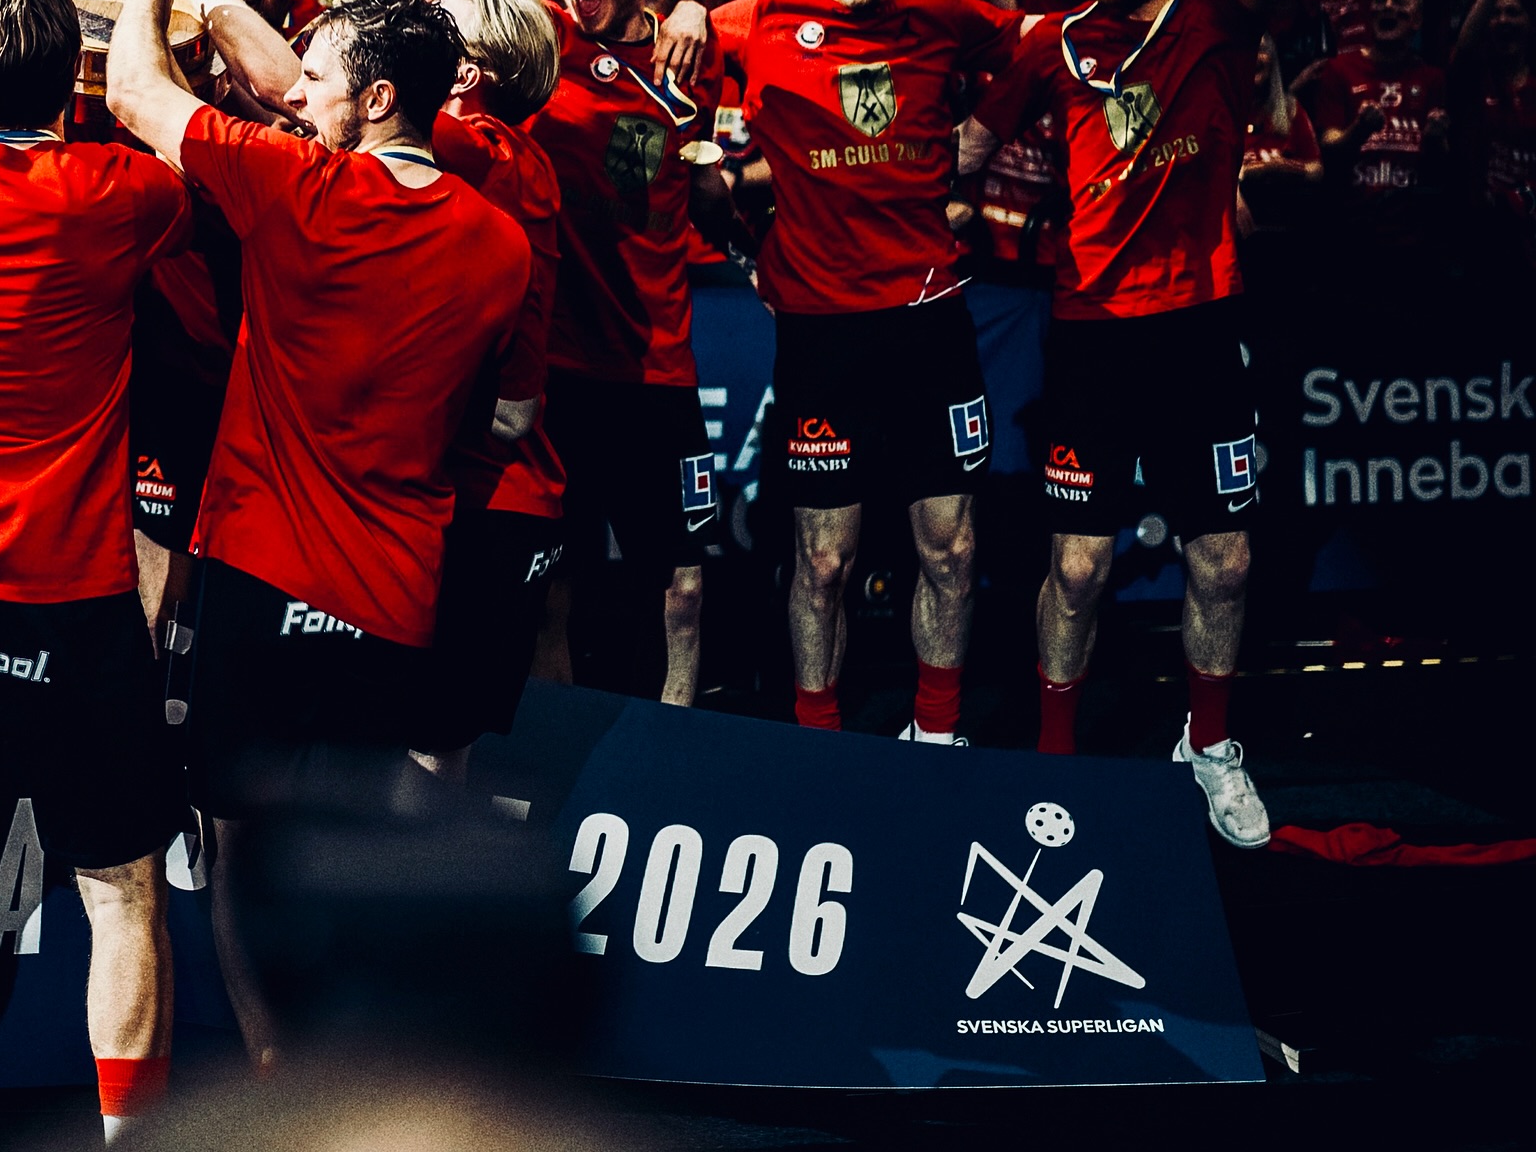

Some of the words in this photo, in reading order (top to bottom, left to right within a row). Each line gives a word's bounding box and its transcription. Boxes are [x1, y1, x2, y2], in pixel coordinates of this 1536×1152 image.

[808, 144, 890, 170] SM-GULD
[1150, 134, 1200, 168] 2026
[1301, 359, 1536, 428] Svensk
[796, 417, 837, 439] ICA
[789, 440, 848, 454] KVANTUM
[1048, 442, 1082, 469] ICA
[787, 457, 851, 472] GRÄNBY
[135, 481, 173, 497] NTUM
[567, 812, 854, 977] 2026
[956, 1019, 1044, 1034] SVENSKA
[1046, 1018, 1165, 1034] SUPERLIGAN
